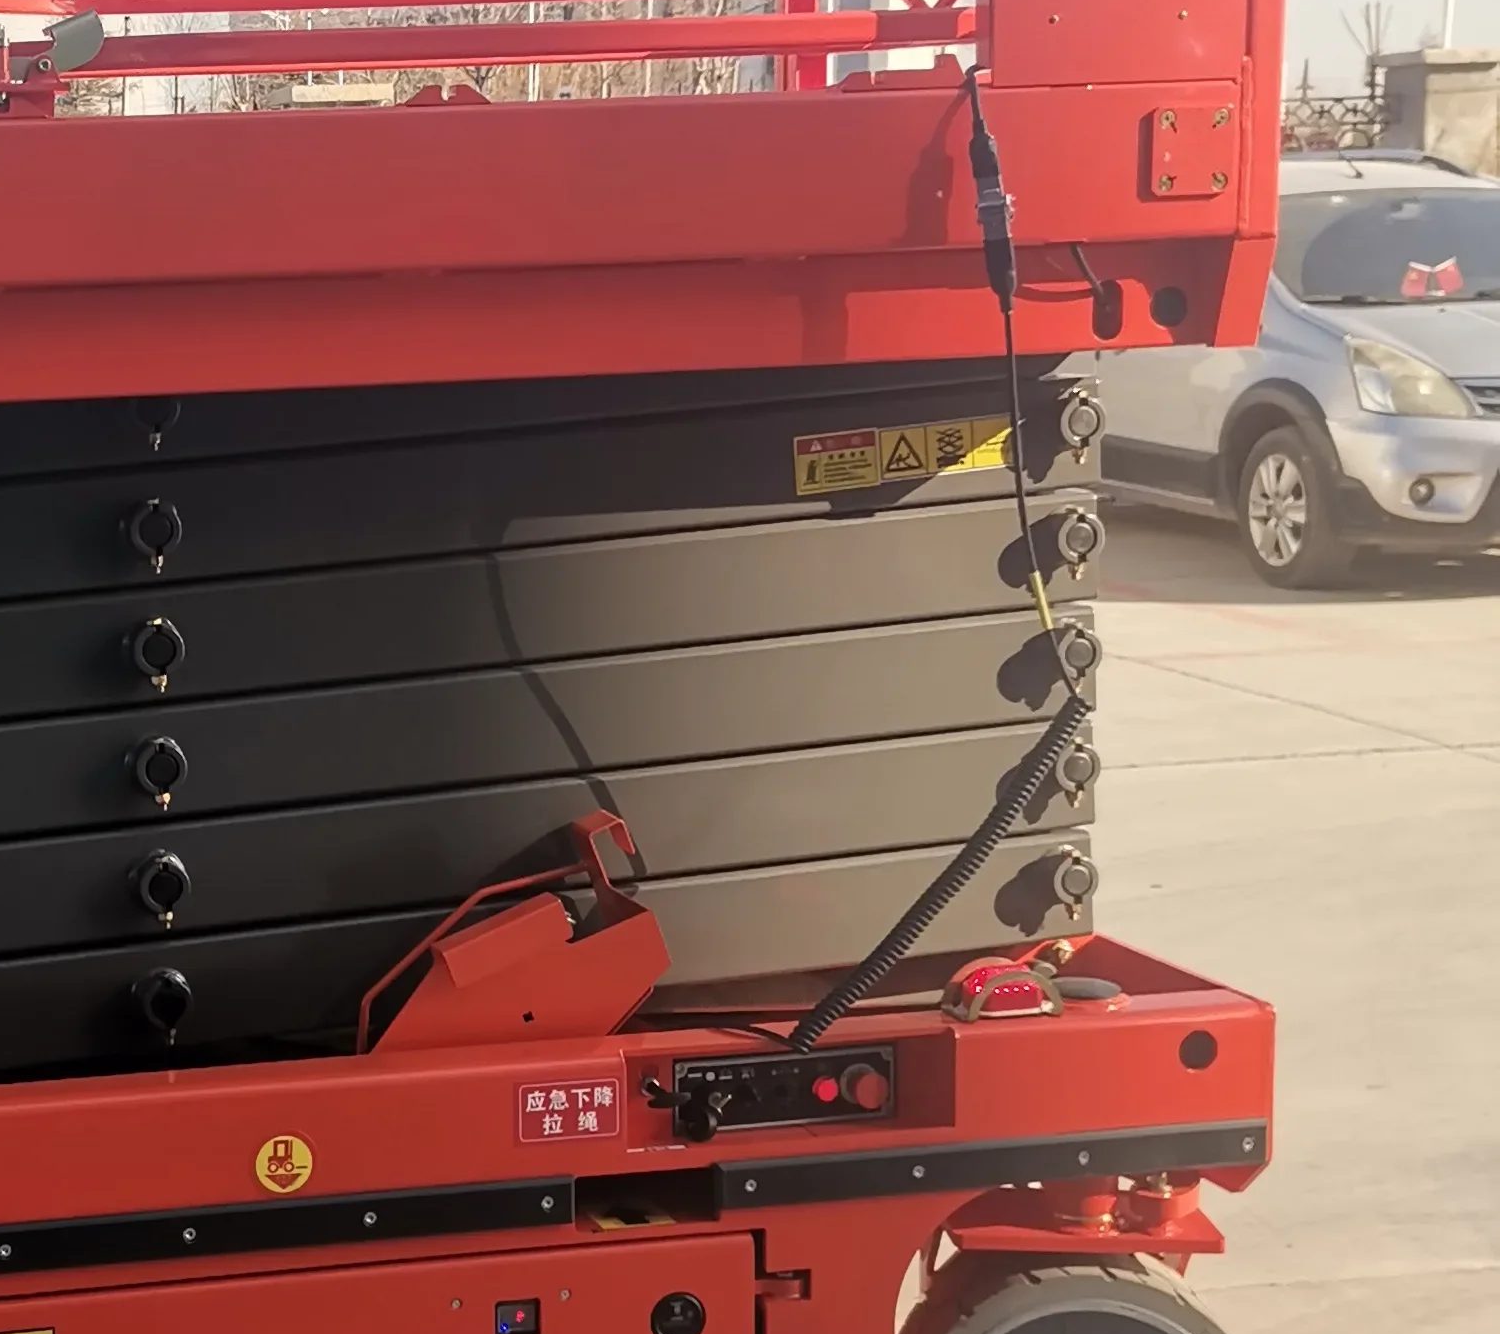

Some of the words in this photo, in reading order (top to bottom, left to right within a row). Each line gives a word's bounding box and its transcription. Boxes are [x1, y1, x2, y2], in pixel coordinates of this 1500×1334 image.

[525, 1085, 614, 1113] 应急下降
[542, 1110, 599, 1136] 拉绳
